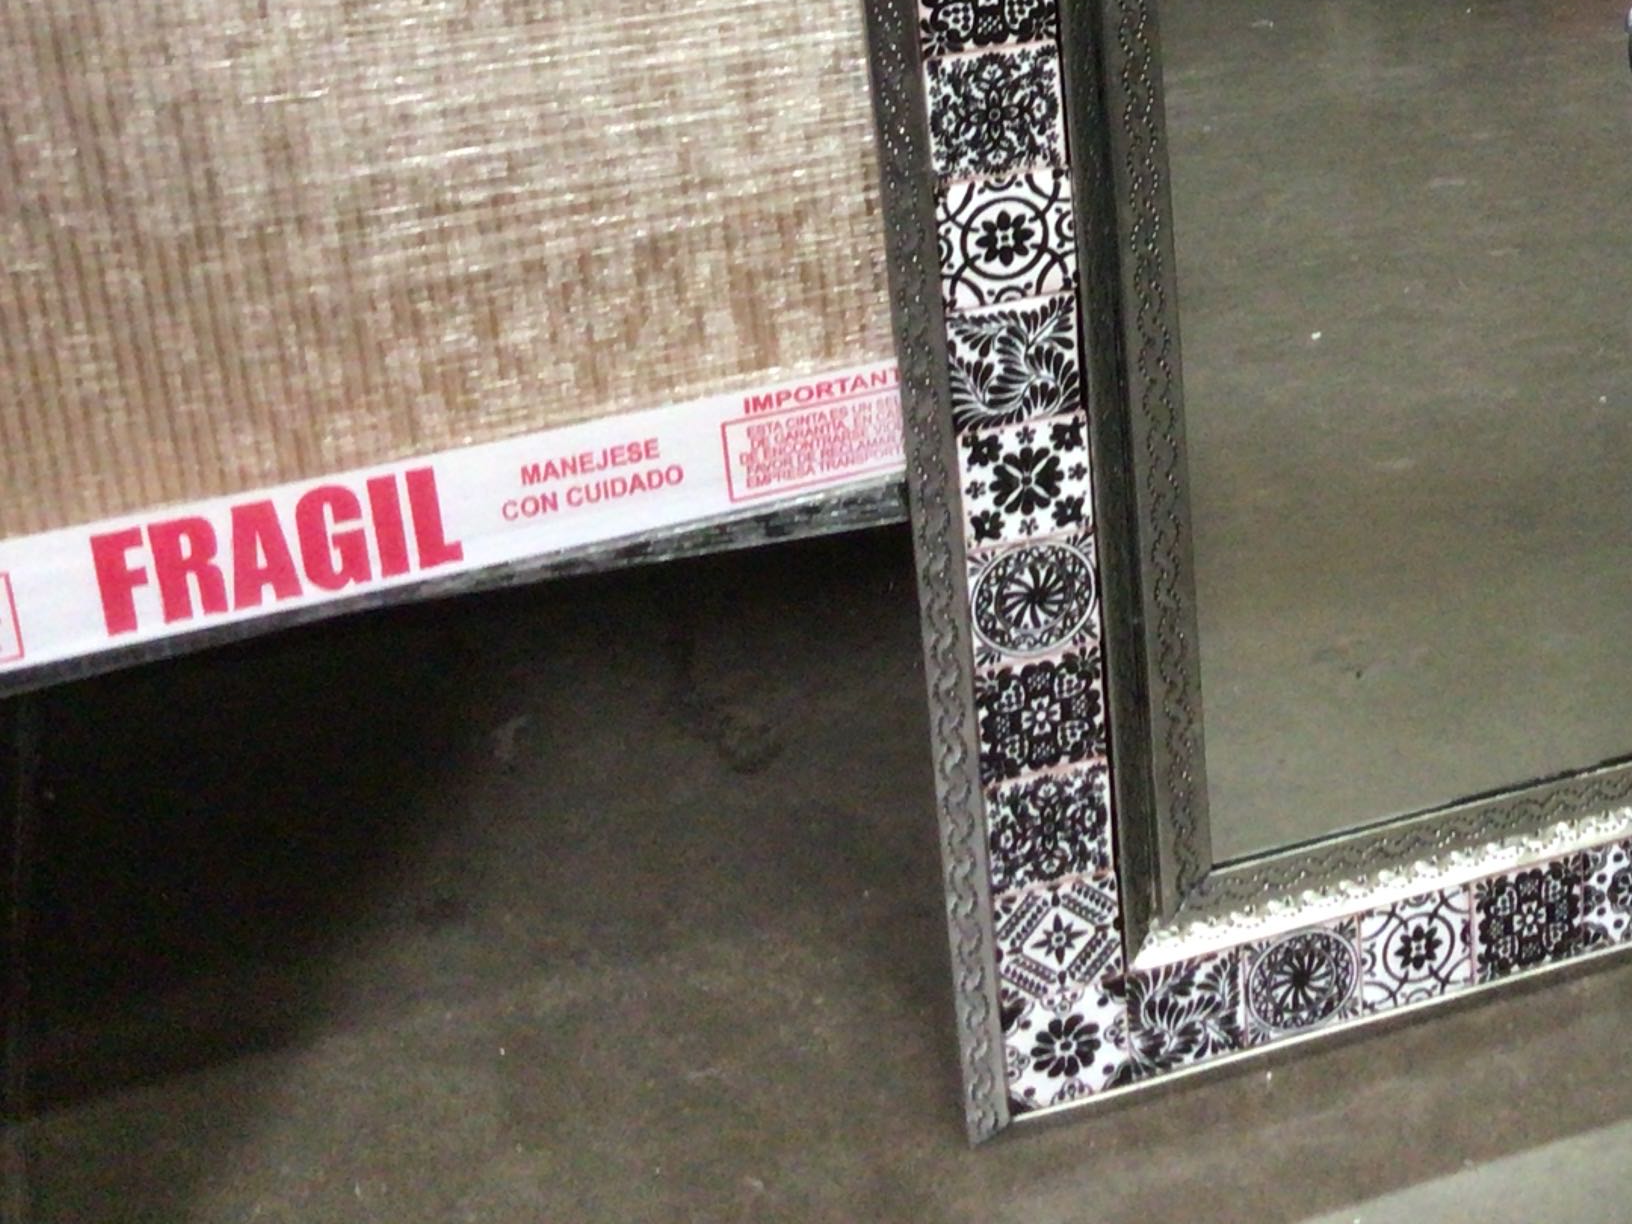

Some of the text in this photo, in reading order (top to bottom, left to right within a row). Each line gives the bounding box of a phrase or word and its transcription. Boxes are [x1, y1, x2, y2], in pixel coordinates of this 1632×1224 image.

[520, 438, 660, 486] MANEJESE
[502, 464, 684, 521] CON CUIDADO
[90, 466, 464, 636] FRAGIL
